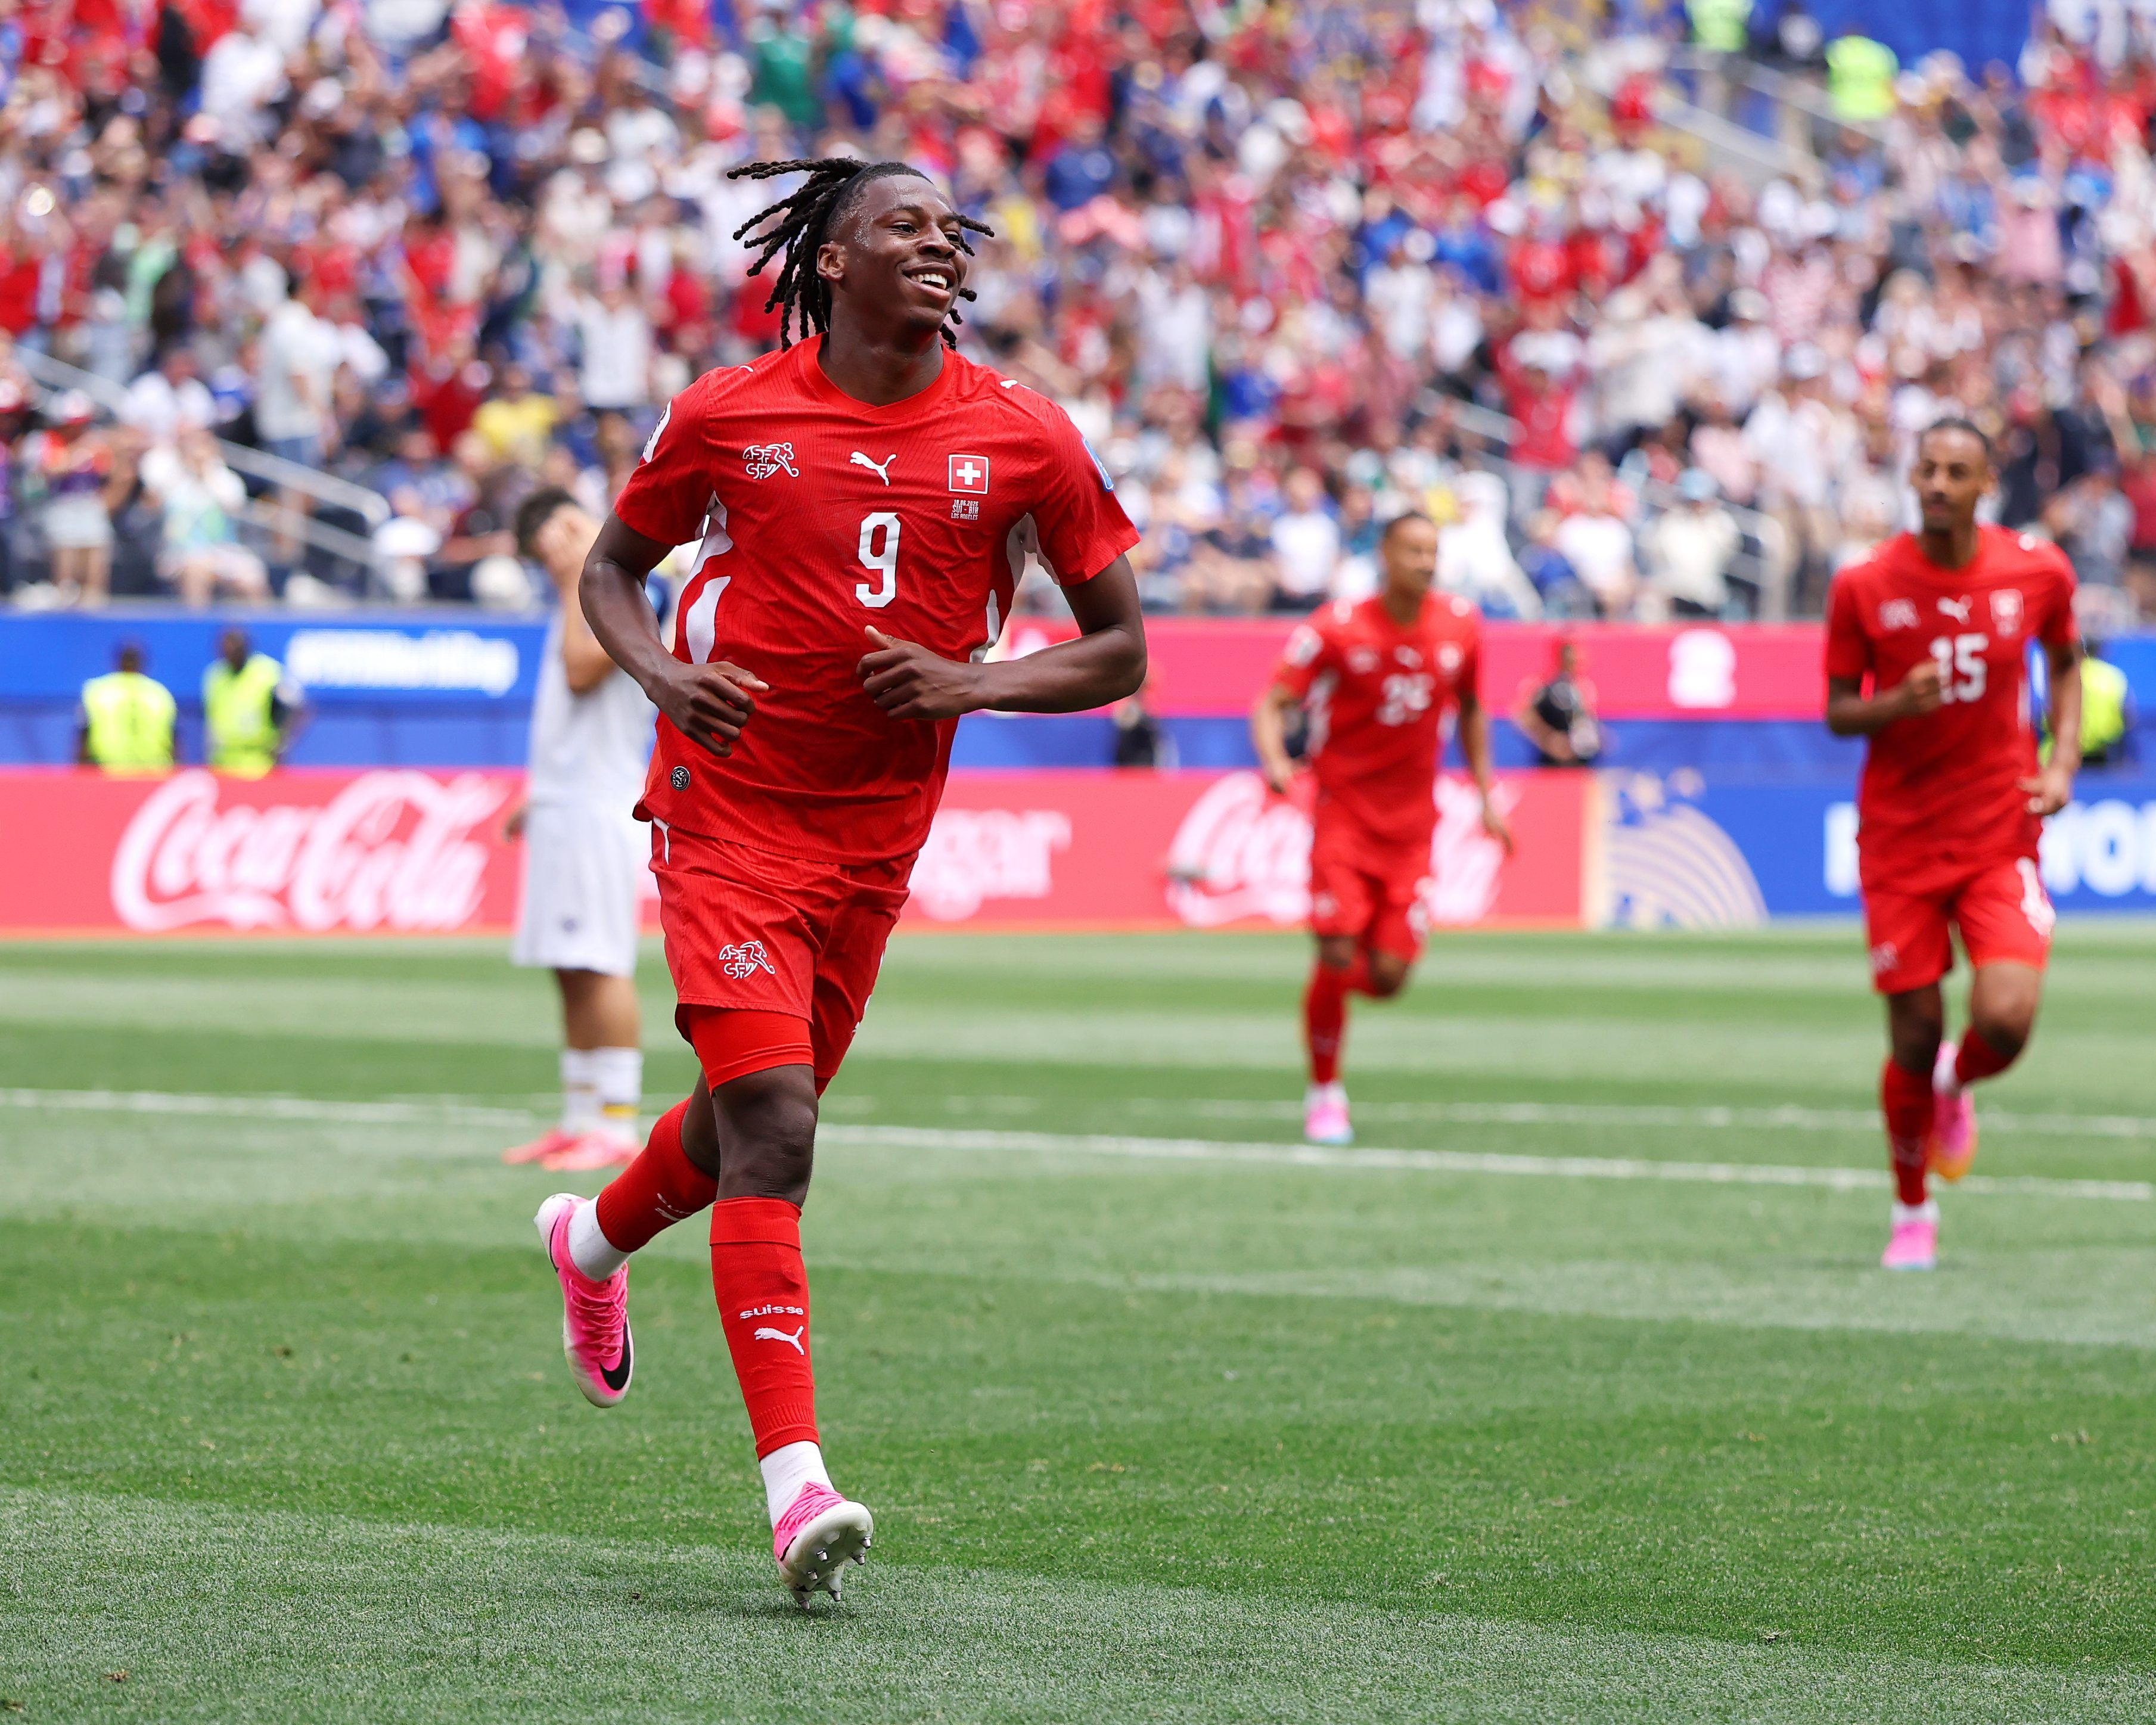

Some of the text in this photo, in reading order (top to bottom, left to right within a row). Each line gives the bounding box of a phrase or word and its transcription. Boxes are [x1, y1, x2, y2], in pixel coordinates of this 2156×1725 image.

[856, 512, 900, 607] 9
[1930, 633, 1989, 704] 15
[740, 1304, 803, 1319] suisse
